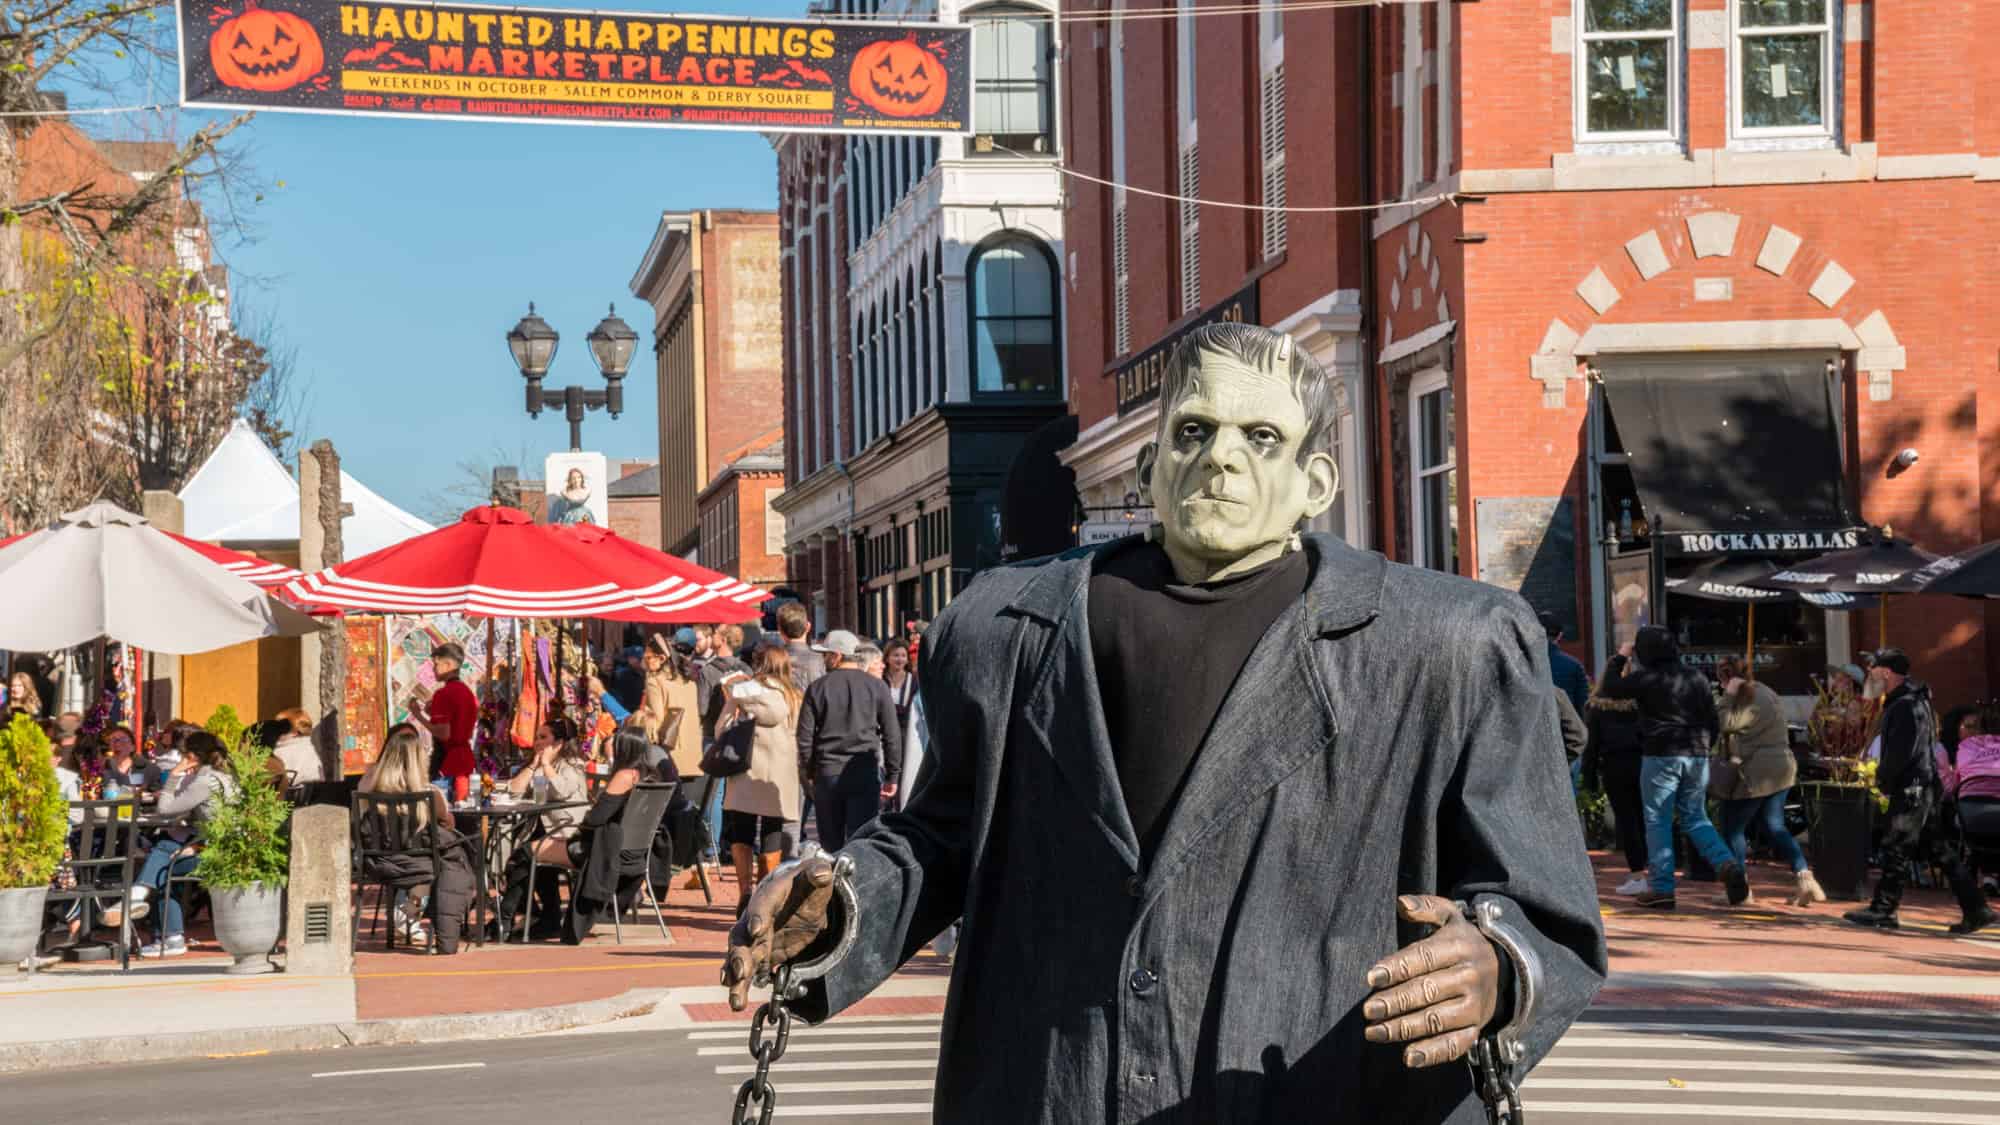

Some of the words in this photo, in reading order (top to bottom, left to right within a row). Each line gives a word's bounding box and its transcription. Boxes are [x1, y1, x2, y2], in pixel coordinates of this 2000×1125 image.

[340, 5, 553, 47] HAUNTED
[564, 18, 835, 59] HAPPENINGS
[428, 44, 756, 85] MARKETPLACE
[368, 76, 450, 90] WEEKENDS
[457, 80, 472, 92] IN
[478, 81, 547, 96] OCTOBER
[564, 86, 611, 98] SALEM
[617, 87, 683, 101] COMMON
[691, 90, 700, 101] &
[707, 90, 752, 103] DERBY
[758, 93, 813, 106] SQUARE
[1681, 531, 1857, 552] ROCKAFELLAS
